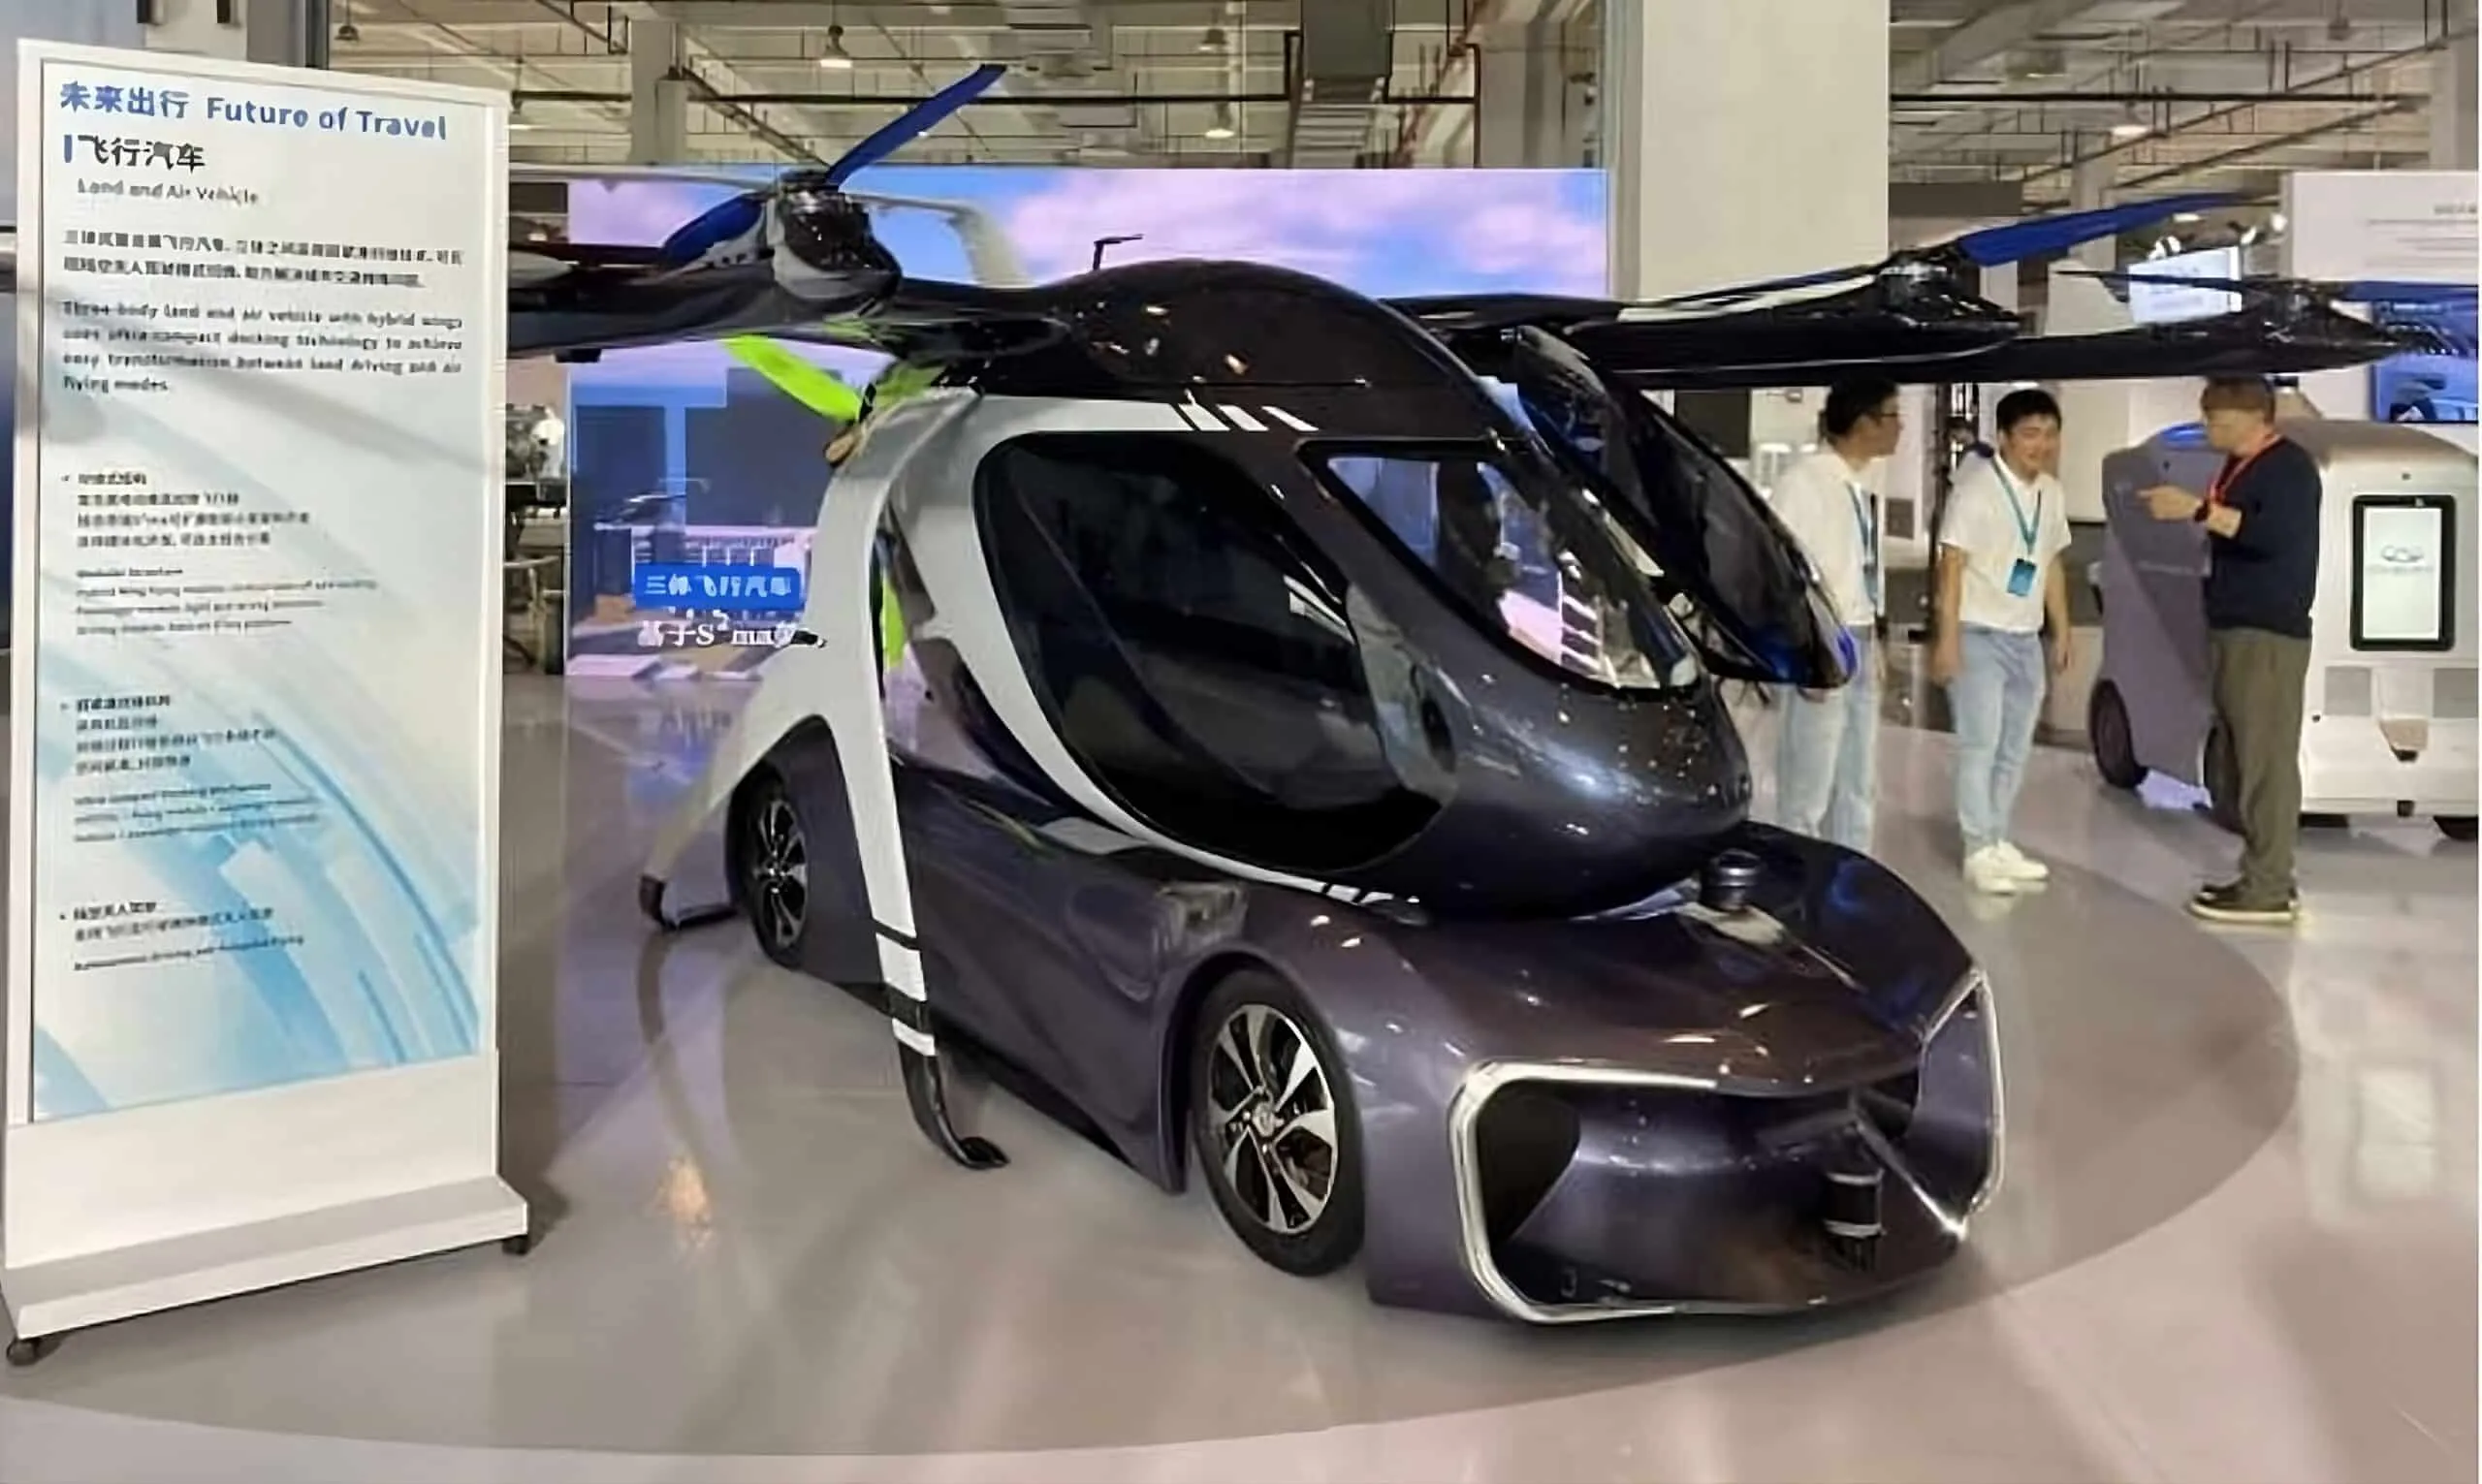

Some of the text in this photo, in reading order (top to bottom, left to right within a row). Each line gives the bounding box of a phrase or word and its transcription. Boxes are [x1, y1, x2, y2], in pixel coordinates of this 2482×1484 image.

[60, 80, 447, 141] 未来出行 Future of Travel
[78, 135, 206, 173] 飞行汽车
[78, 178, 258, 206] Land and Air Vehicle
